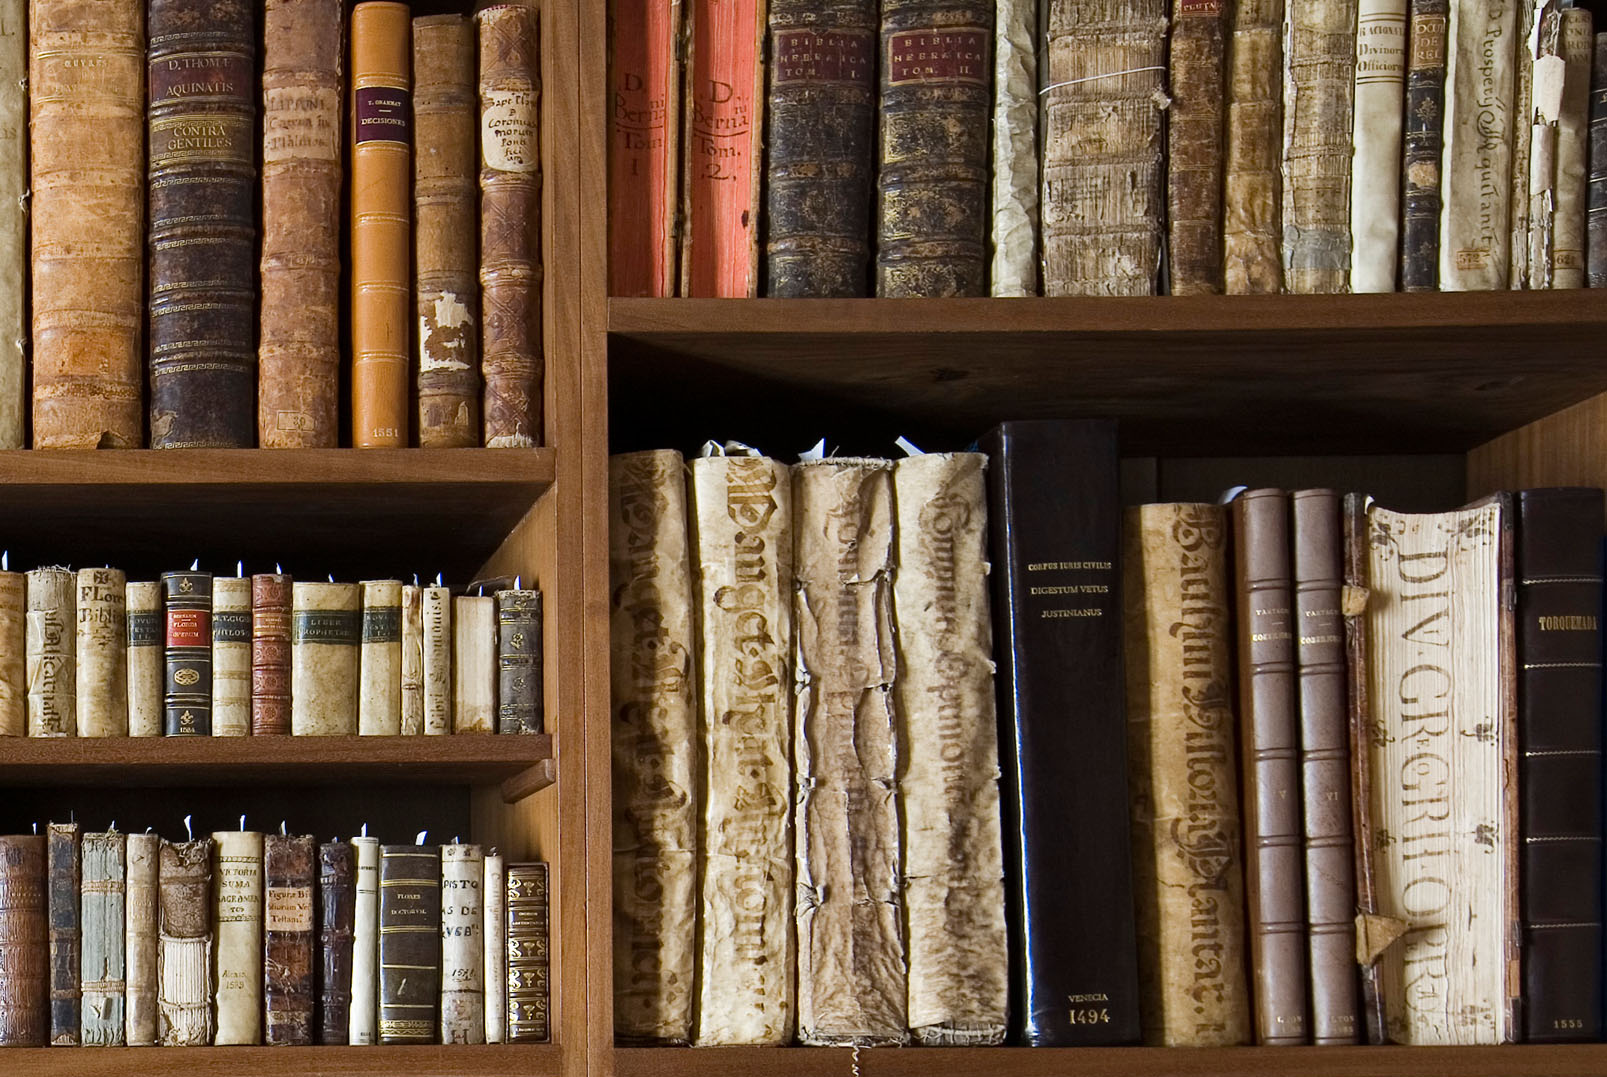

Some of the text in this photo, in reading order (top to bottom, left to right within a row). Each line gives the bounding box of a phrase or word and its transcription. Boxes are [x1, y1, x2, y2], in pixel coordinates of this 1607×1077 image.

[791, 38, 857, 49] BIBLIA
[904, 36, 976, 47] BIBLIA
[165, 81, 234, 94] AQUINATIS
[174, 125, 226, 137] CONTRA
[168, 137, 231, 150] GENTILES
[1028, 562, 1058, 571] CORPUS
[1031, 585, 1109, 595] DIGESTUM VETUS
[1041, 608, 1103, 618] JUSTINIANUS
[1538, 616, 1598, 631] TORQUEMADA
[1069, 1008, 1111, 1026] 1494
